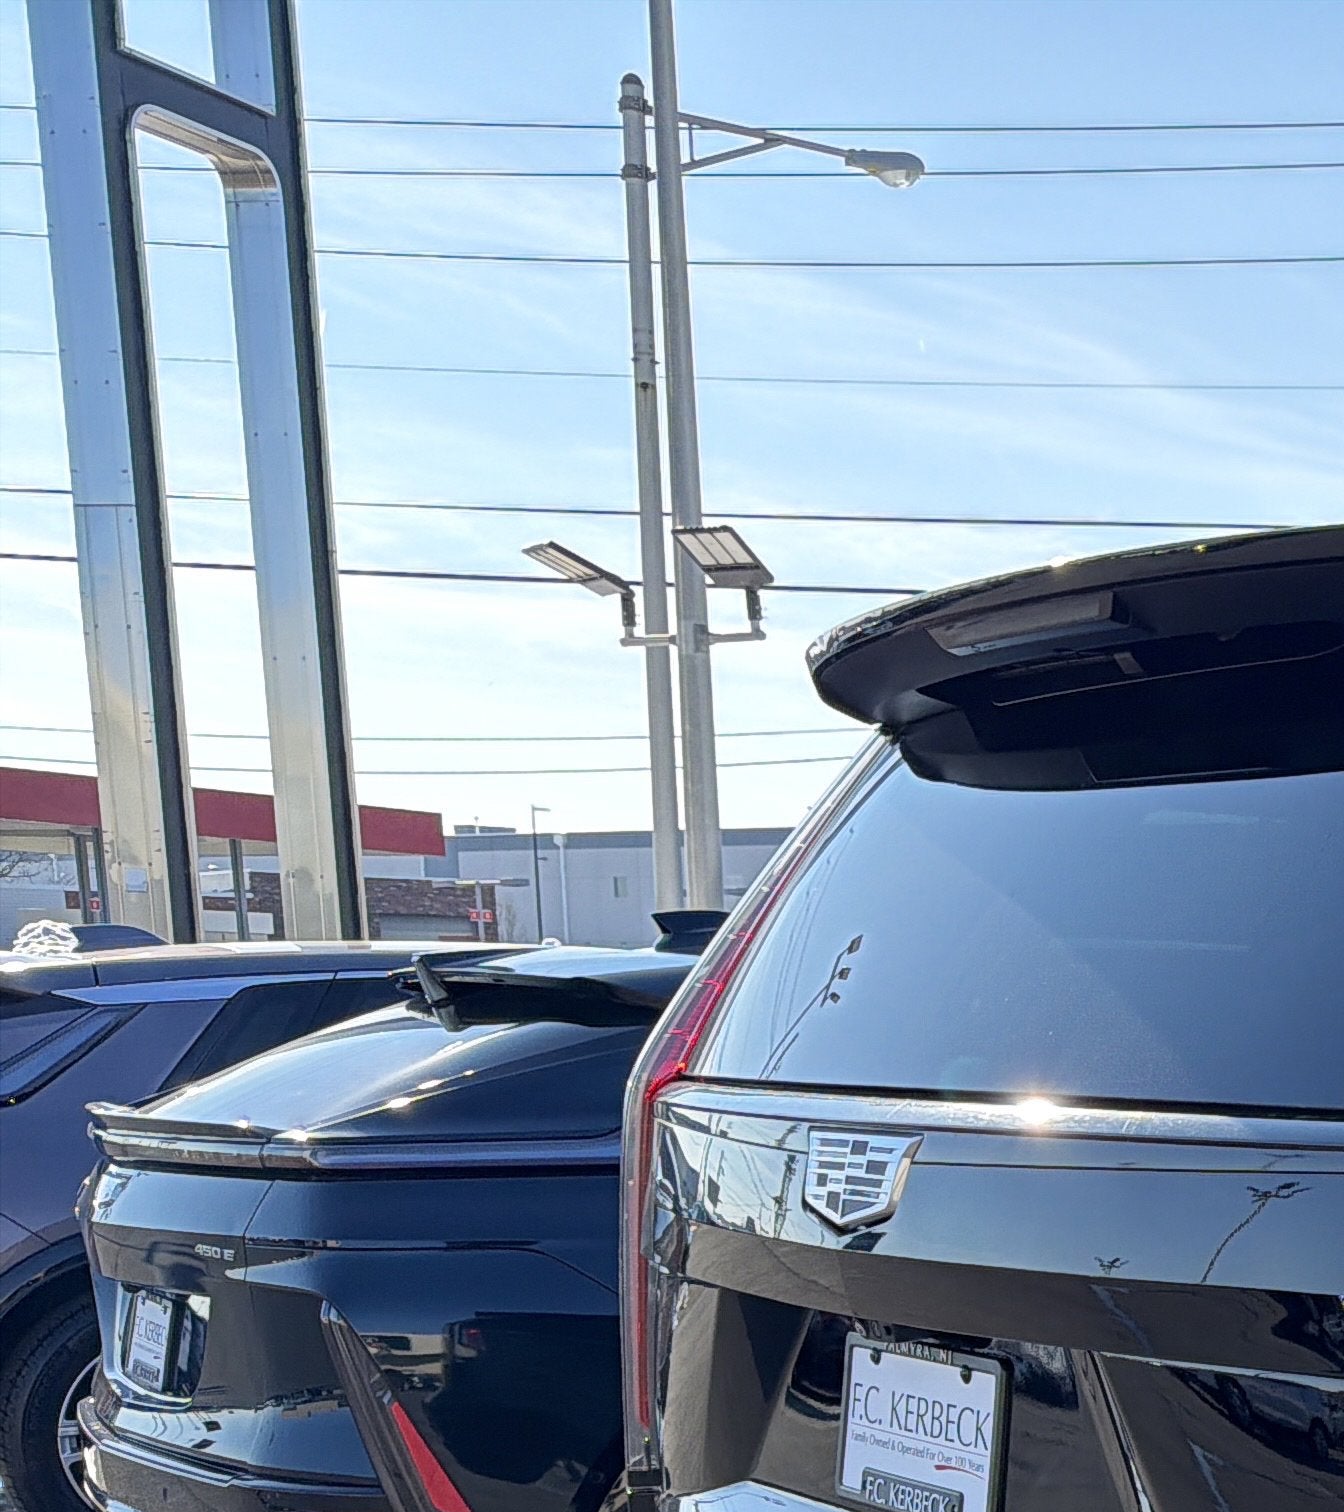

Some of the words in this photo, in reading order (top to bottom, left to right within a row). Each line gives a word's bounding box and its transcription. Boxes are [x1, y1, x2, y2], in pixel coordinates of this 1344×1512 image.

[195, 1243, 221, 1259] 450
[223, 1249, 235, 1261] E
[852, 1382, 882, 1425] F.C.
[889, 1390, 990, 1451] KERBECK
[870, 1433, 890, 1449] Owned
[897, 1440, 925, 1458] Operated
[926, 1447, 937, 1461] For
[937, 1450, 953, 1464] Over
[955, 1456, 967, 1469] 100
[968, 1458, 985, 1473] Years
